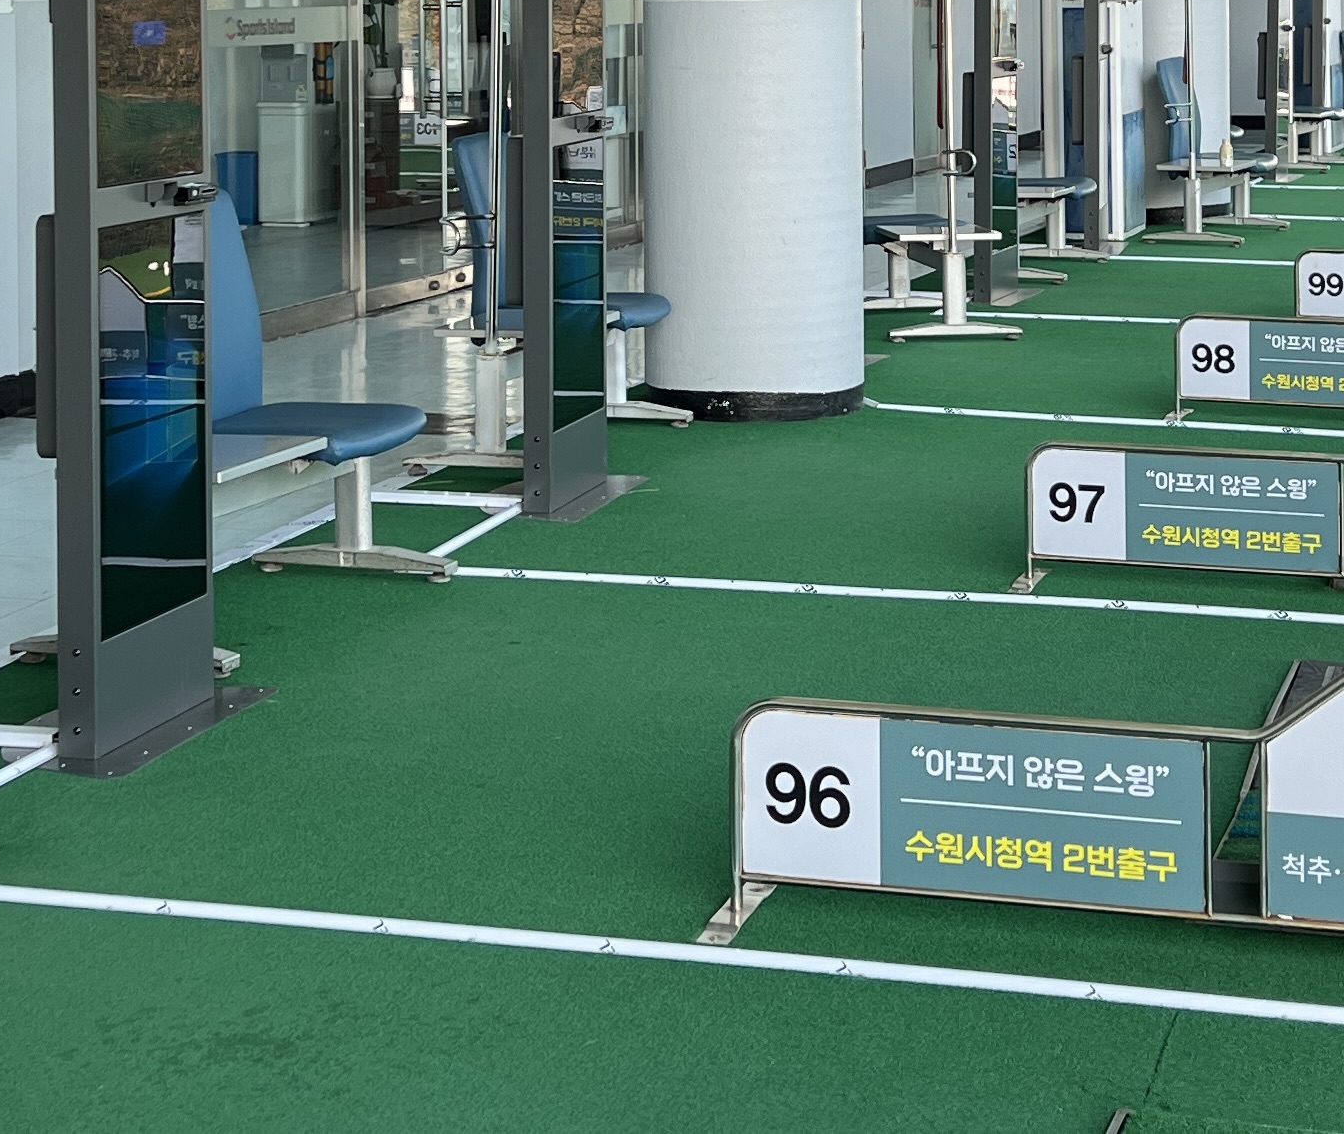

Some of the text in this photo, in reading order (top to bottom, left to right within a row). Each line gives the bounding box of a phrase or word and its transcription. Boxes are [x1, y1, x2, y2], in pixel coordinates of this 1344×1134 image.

[1308, 272, 1344, 297] 99
[1191, 342, 1236, 374] 98
[1261, 372, 1334, 392] 수원시청역
[1220, 474, 1261, 498] 않은
[1048, 481, 1106, 524] 97
[1141, 523, 1323, 555] 수원시청역 2번출구
[1023, 755, 1085, 793] 않은
[764, 761, 851, 829] 96
[904, 829, 1179, 883] 수원시청역 2번출구
